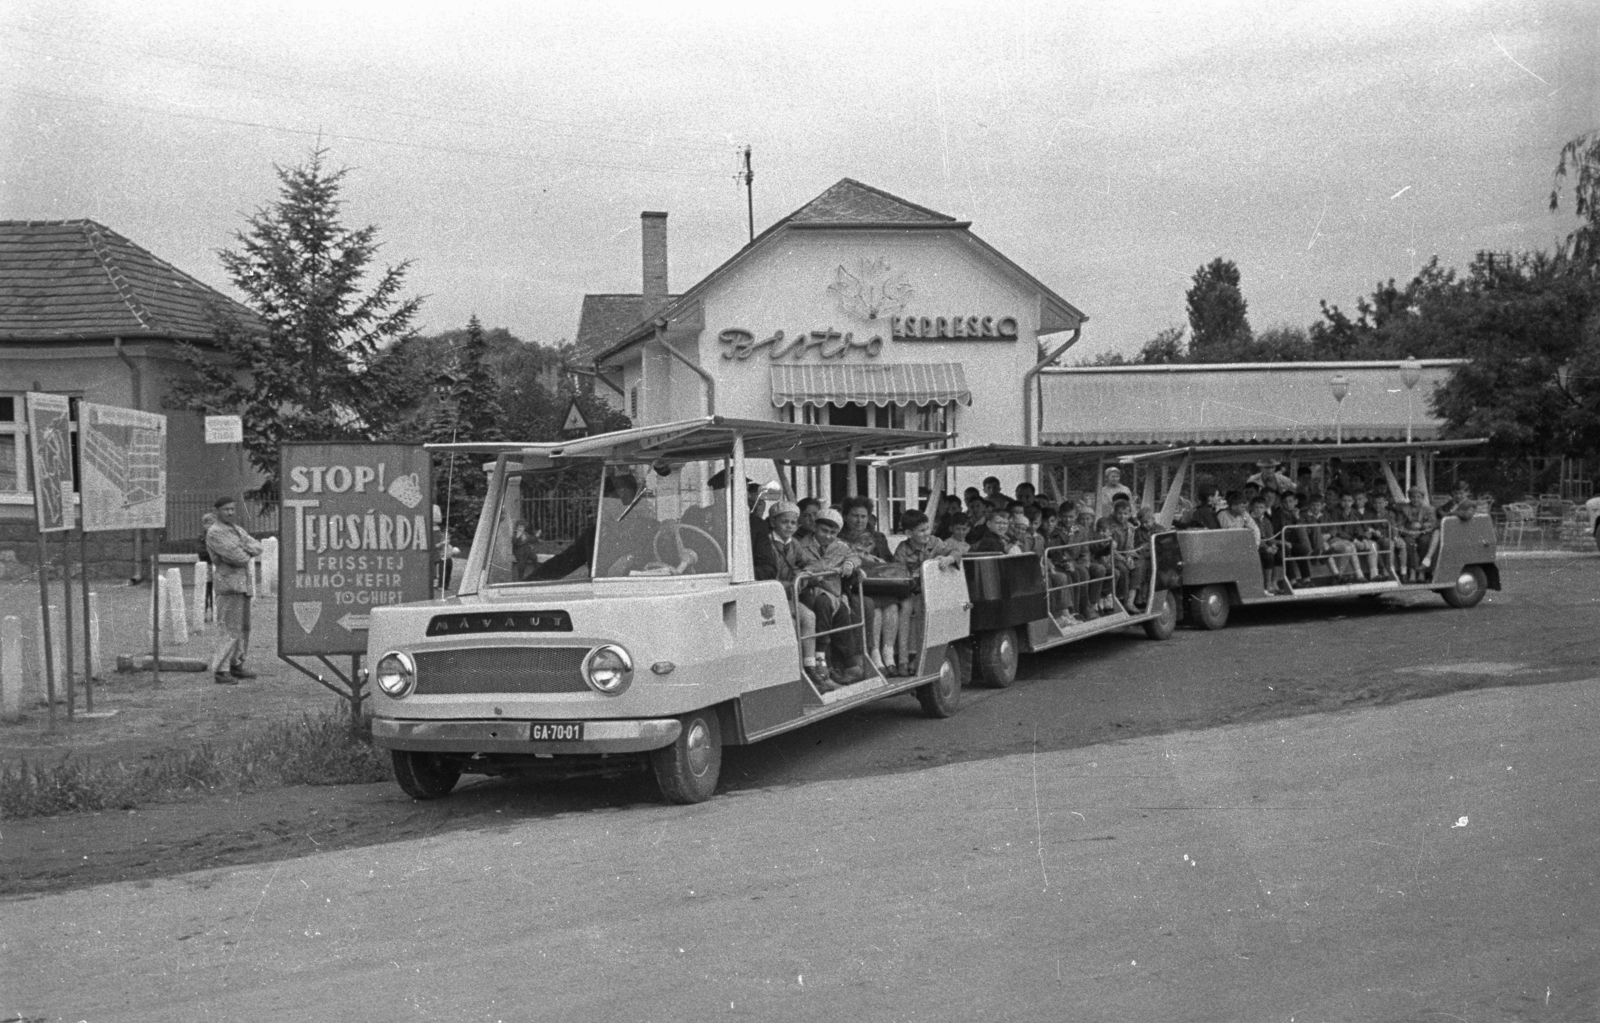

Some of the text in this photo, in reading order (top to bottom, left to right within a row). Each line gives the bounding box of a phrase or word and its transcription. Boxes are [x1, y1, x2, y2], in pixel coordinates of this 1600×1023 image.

[890, 315, 1018, 338] ESPRESSO
[718, 327, 883, 360] Bistro
[289, 462, 386, 493] STOP!
